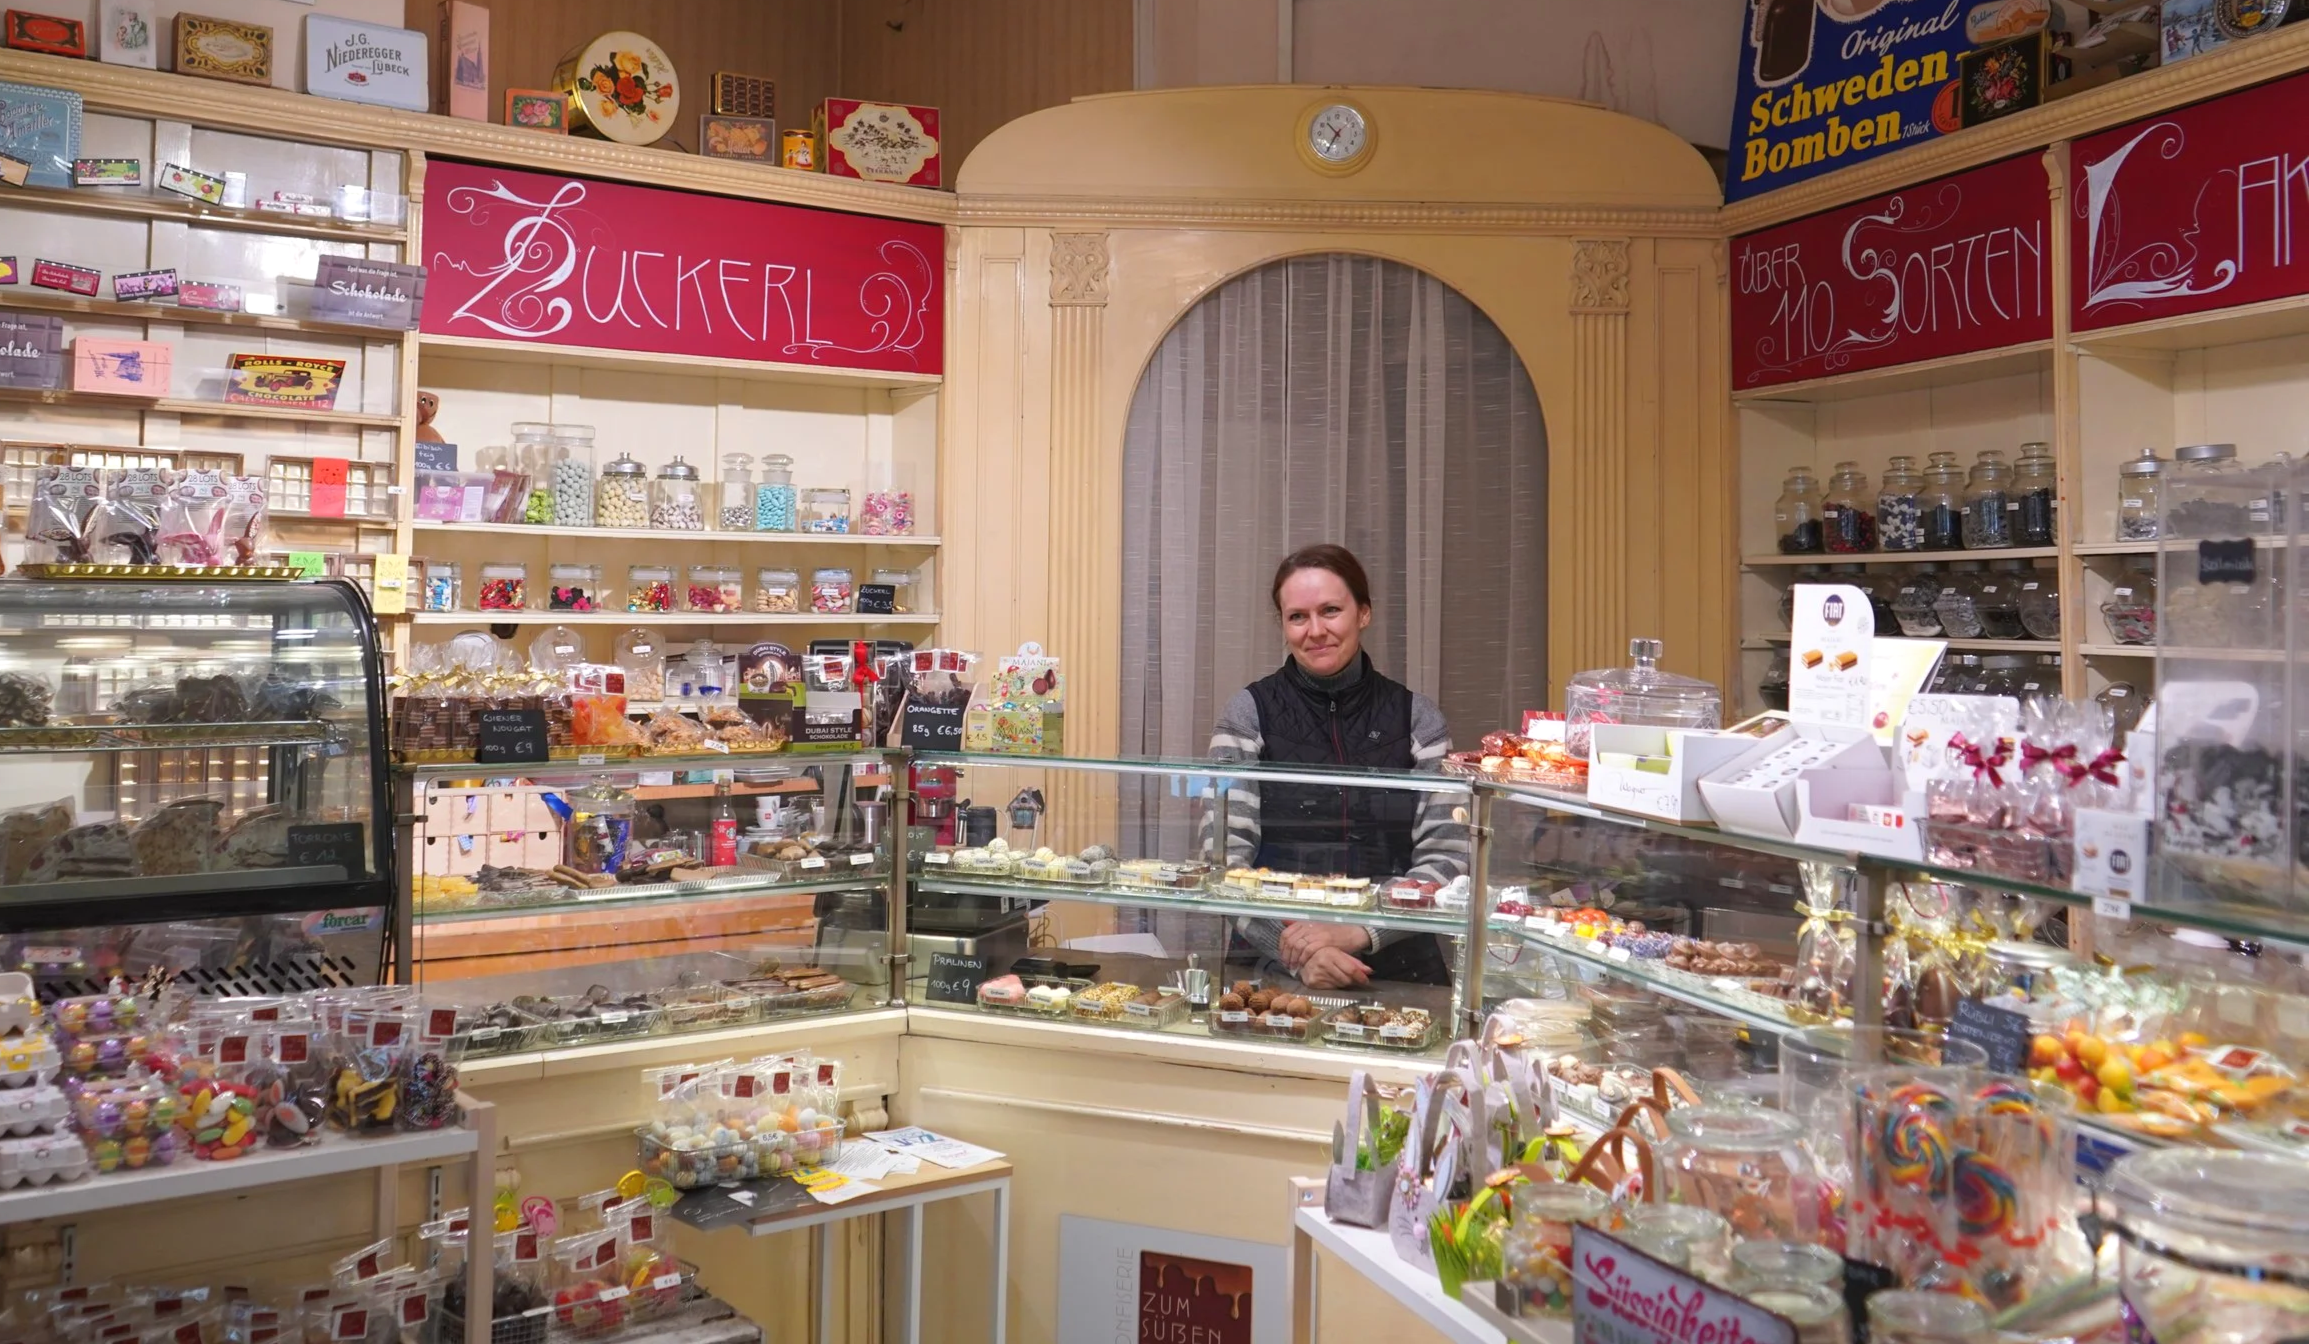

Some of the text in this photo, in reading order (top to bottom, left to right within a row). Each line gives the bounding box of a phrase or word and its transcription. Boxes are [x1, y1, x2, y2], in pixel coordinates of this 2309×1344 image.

[1841, 0, 1960, 60] Original
[345, 33, 370, 48] J.G.
[371, 59, 410, 77] LÜBECK
[1741, 110, 1902, 182] Bomben
[447, 181, 833, 345] ZUCKERL
[1739, 242, 1805, 294] ÜBER
[376, 269, 390, 278] Frage
[1770, 197, 2042, 361] 110 SORTEN
[328, 280, 408, 303] Schokolade
[244, 358, 283, 368] ROLLS
[295, 360, 335, 373] ROYCE
[247, 390, 316, 402] CHOCOLATE
[311, 399, 330, 408] 112
[59, 472, 93, 481] 28 LOTS
[127, 472, 158, 482] 28 LOTS
[188, 473, 218, 483] 28 LOTS
[229, 481, 256, 491] 28 LOTS
[1824, 602, 1844, 619] FIAT
[906, 704, 960, 716] ORANGETTE
[492, 724, 534, 734] NOUGAT
[805, 726, 853, 735] DUBAI STYLE
[322, 912, 368, 929] forcar
[933, 954, 982, 969] PRALINEN
[1142, 1291, 1190, 1318] ZUM
